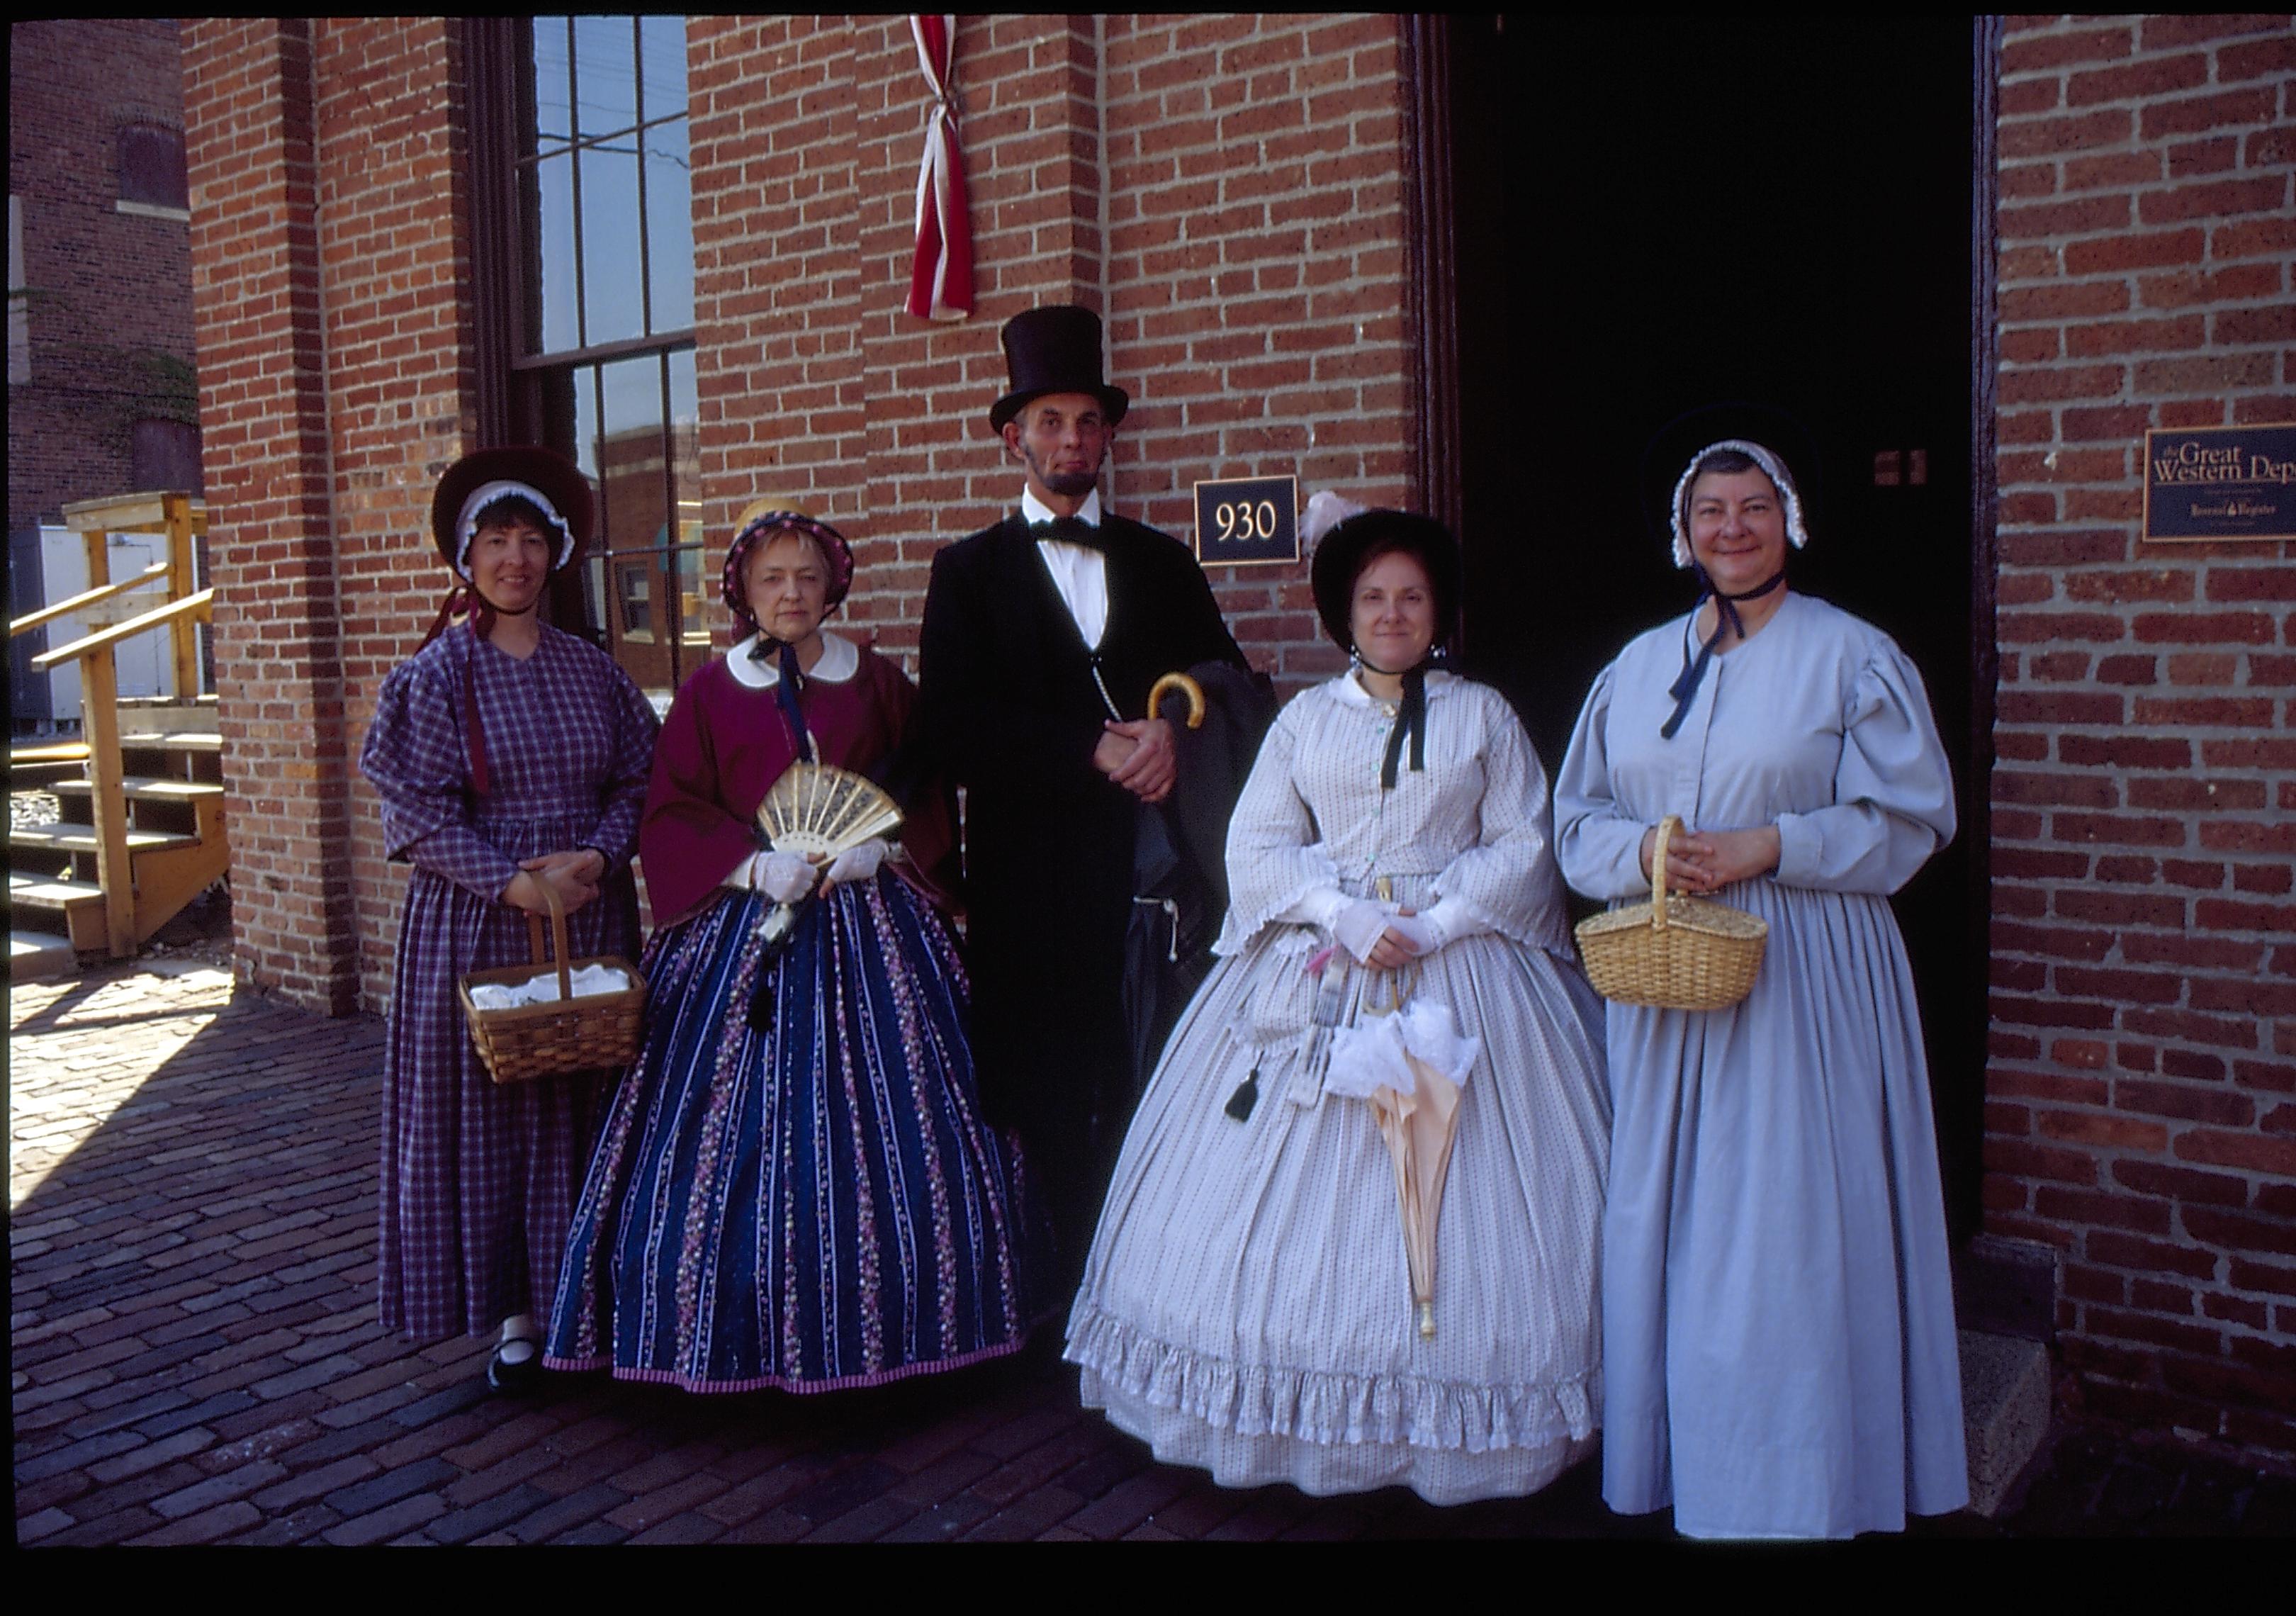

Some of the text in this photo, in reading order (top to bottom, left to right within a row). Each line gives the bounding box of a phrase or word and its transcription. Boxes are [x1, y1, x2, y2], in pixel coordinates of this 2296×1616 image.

[2180, 442, 2242, 465] Great
[2154, 459, 2243, 482] Western
[1216, 500, 1276, 542] 930
